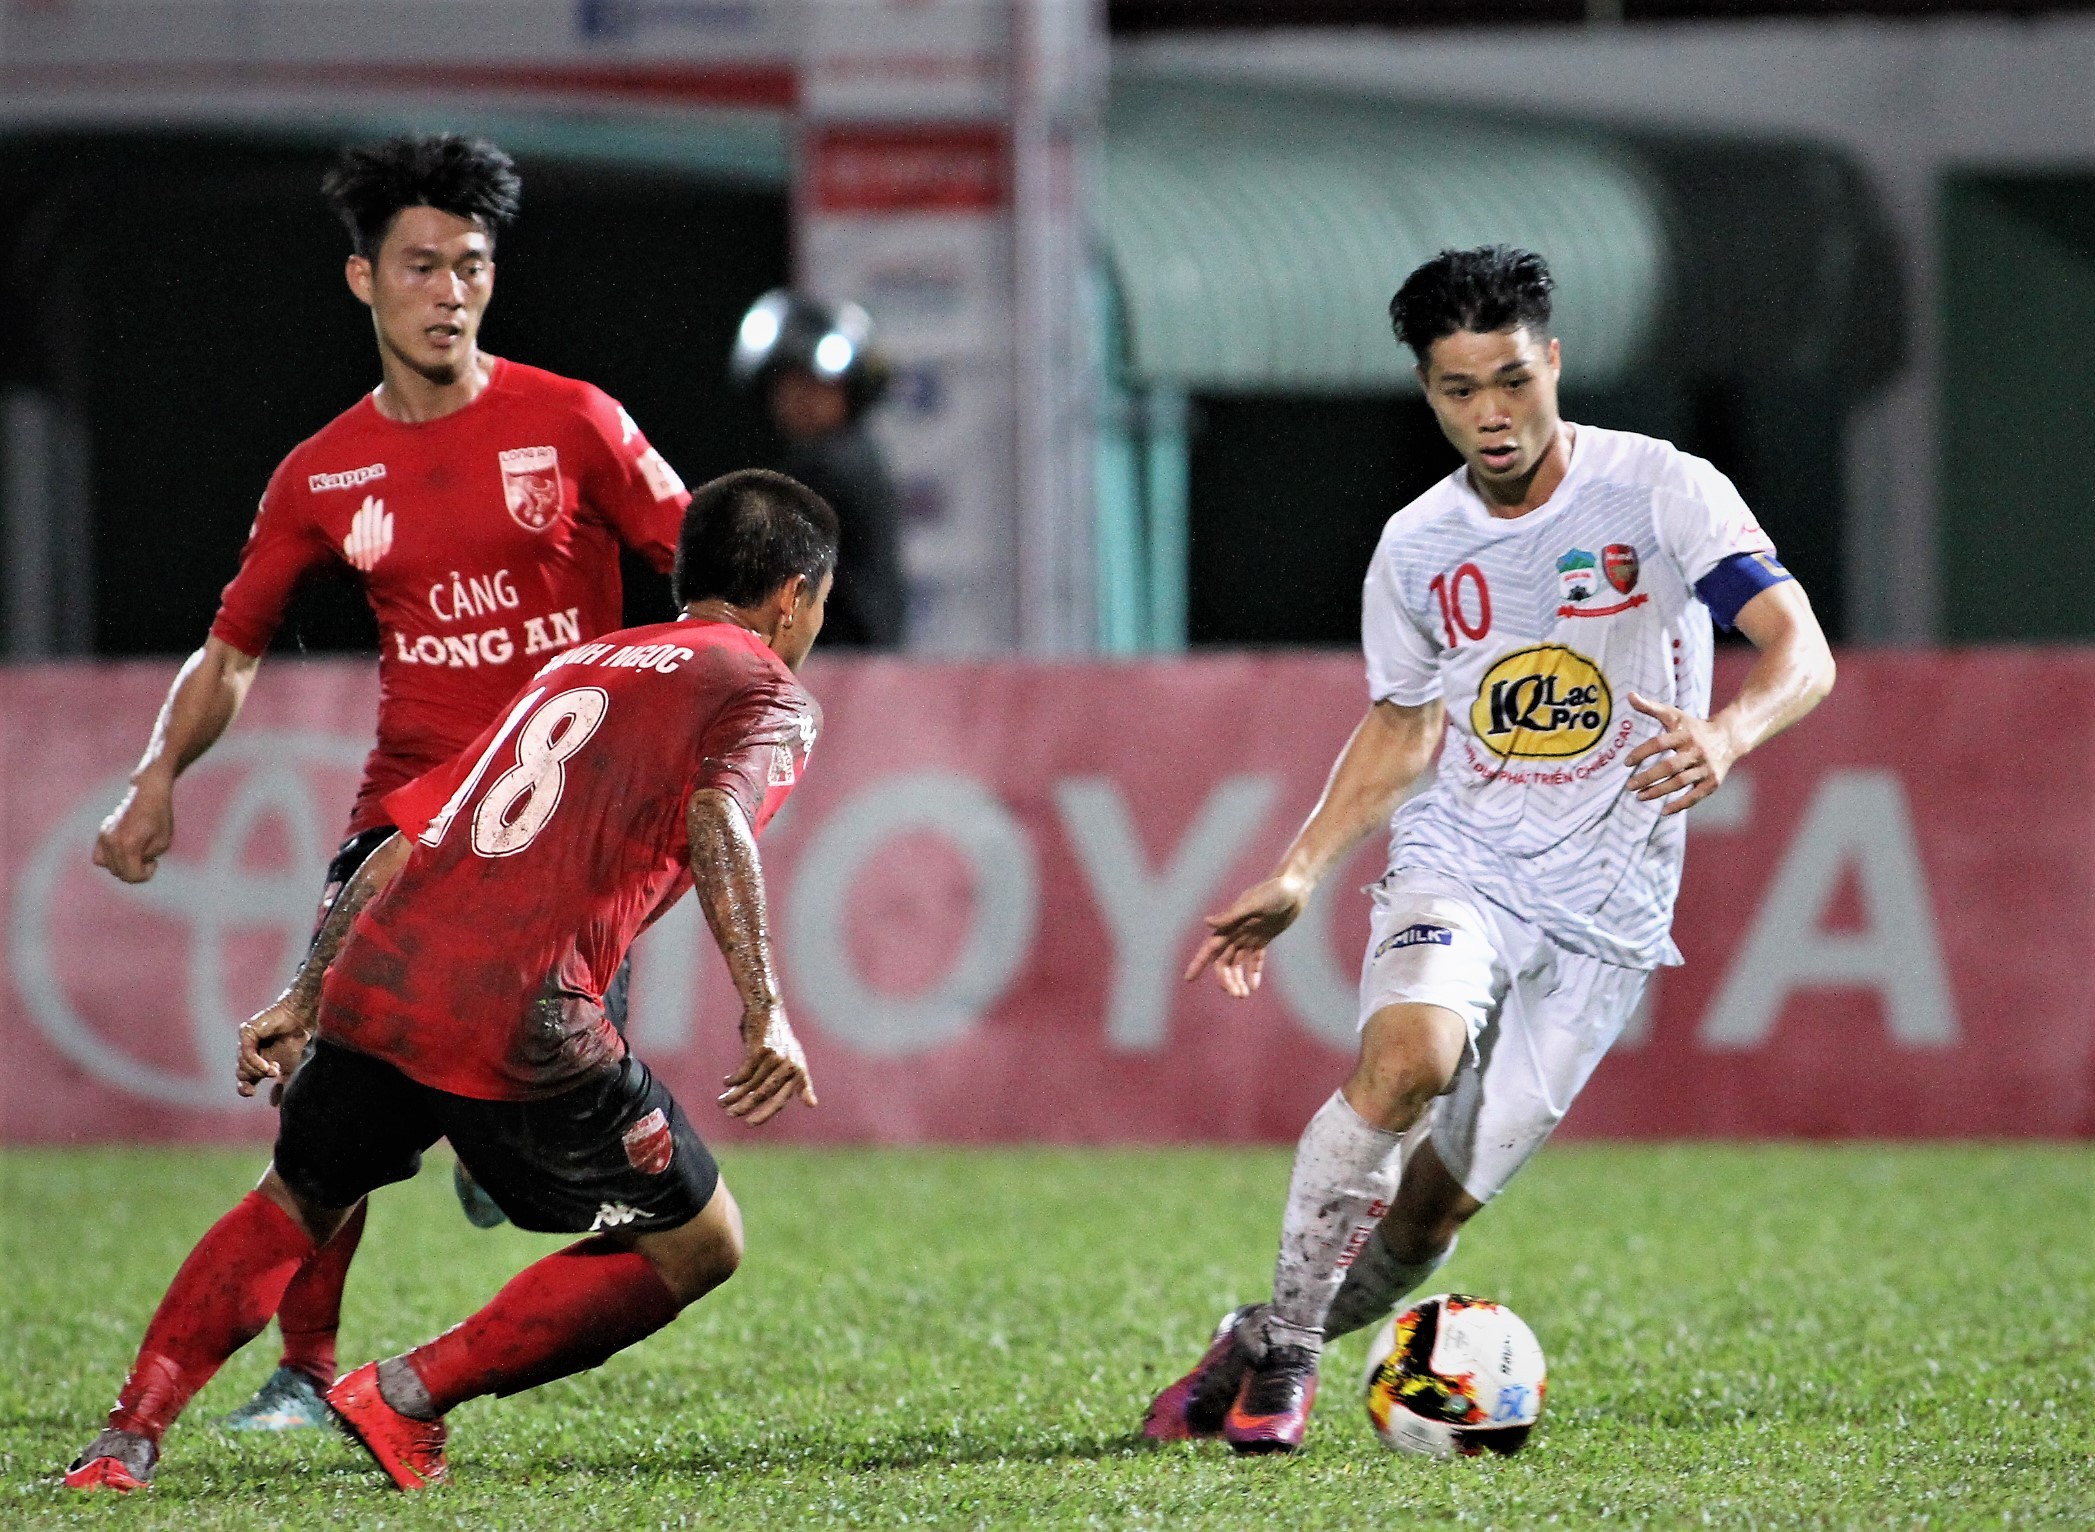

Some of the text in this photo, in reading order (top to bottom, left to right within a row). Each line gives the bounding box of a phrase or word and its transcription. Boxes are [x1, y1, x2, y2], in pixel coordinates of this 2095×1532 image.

[309, 463, 387, 493] Kappa
[429, 569, 519, 622] CẢNG
[1429, 563, 1491, 648] 10
[395, 607, 581, 668] LONG AN
[600, 644, 694, 674] NGỌC
[1487, 674, 1553, 735] IQ
[1545, 676, 1598, 708] Lac
[1551, 708, 1601, 731] Pro
[418, 685, 610, 858] 18
